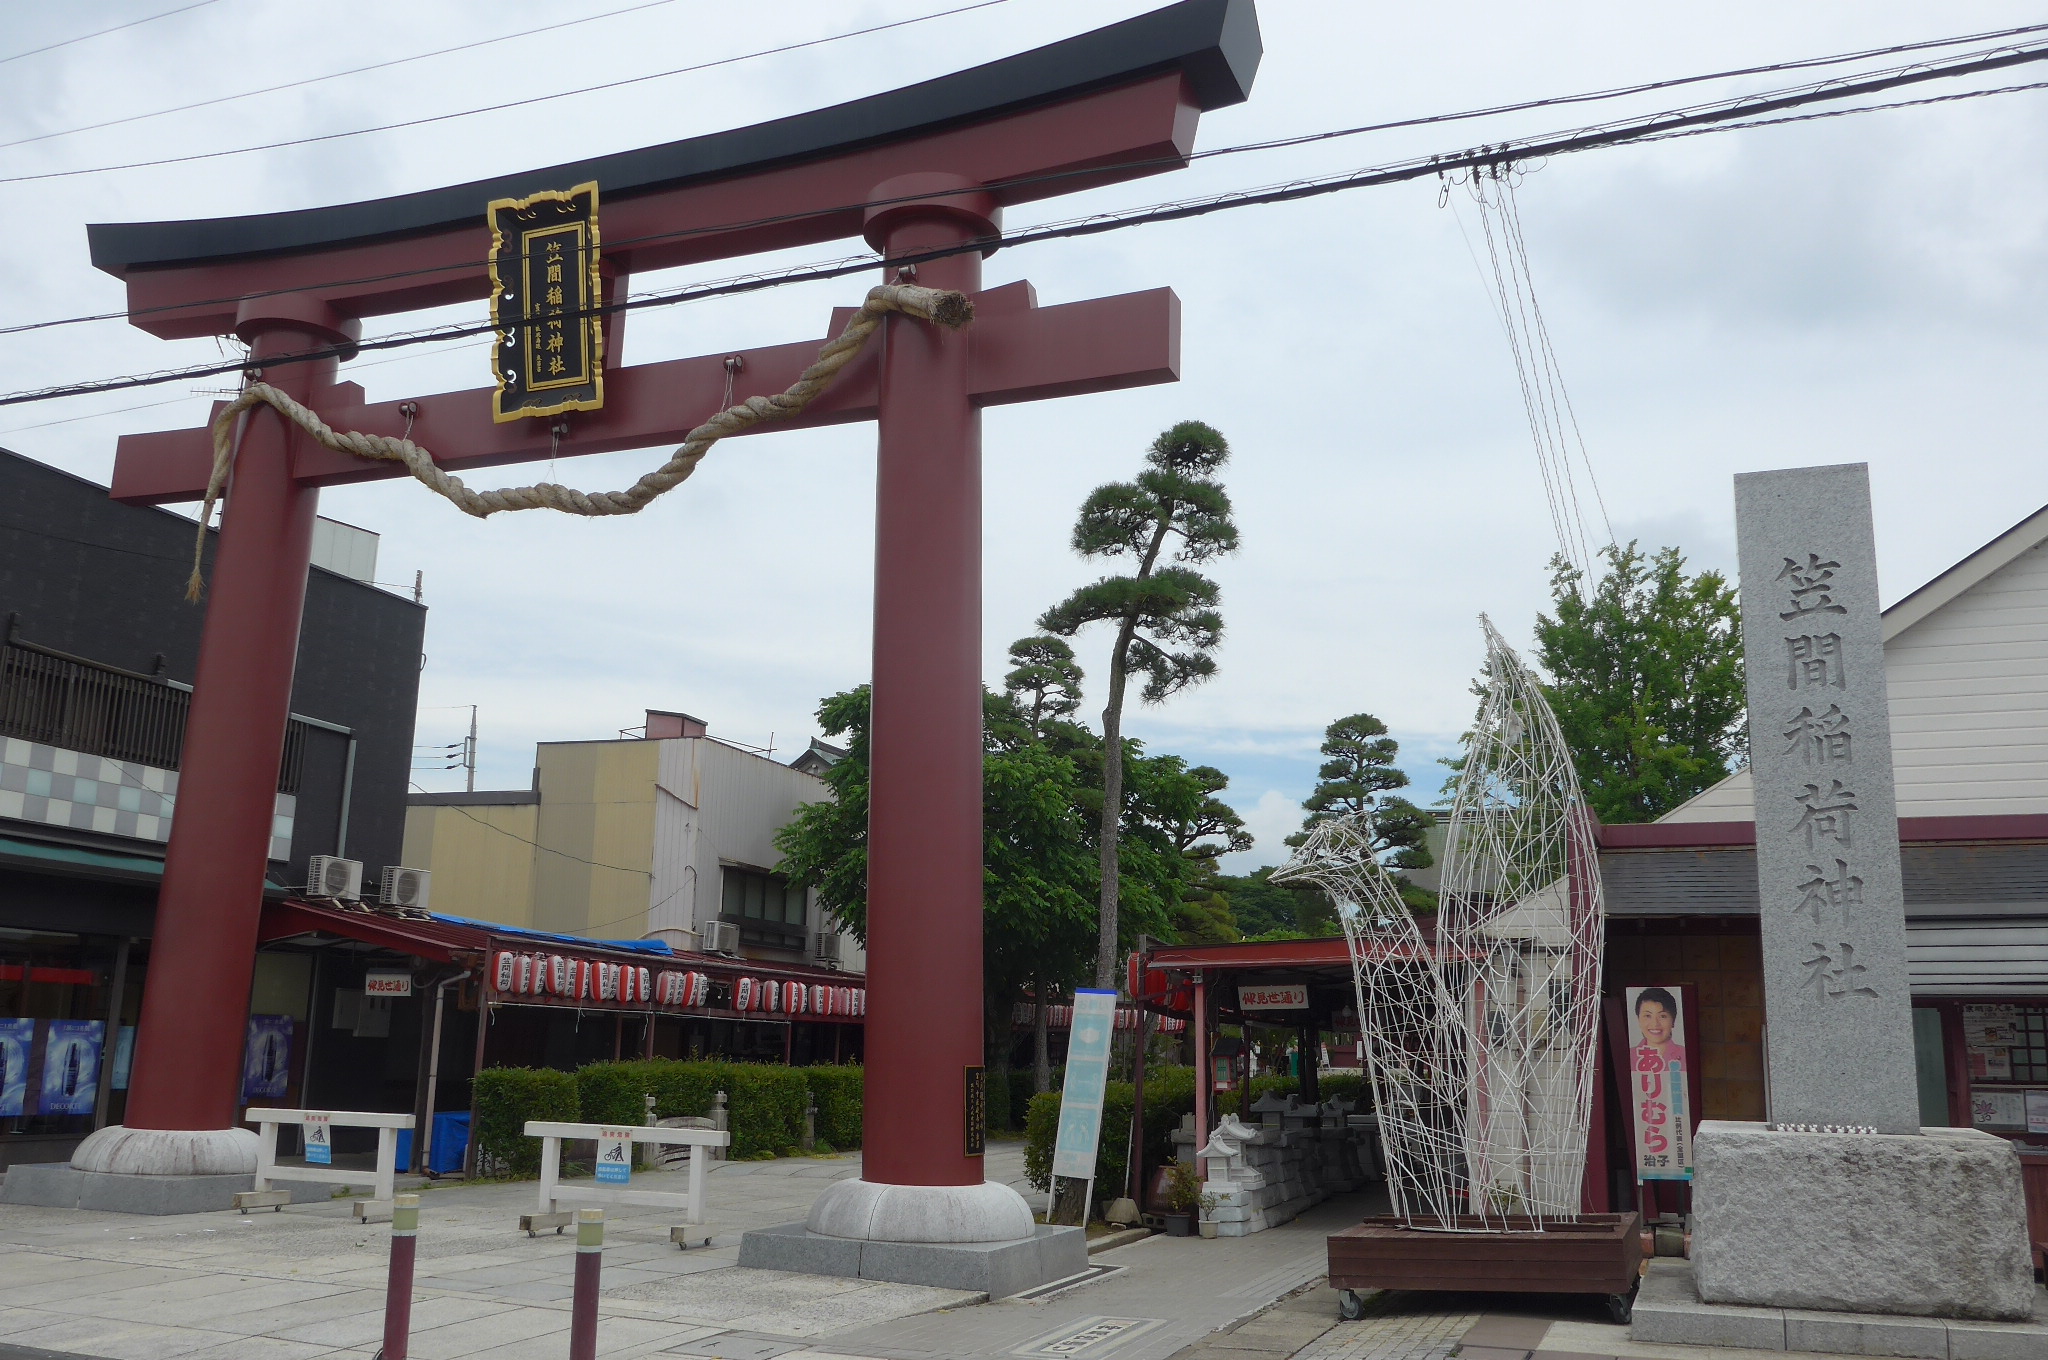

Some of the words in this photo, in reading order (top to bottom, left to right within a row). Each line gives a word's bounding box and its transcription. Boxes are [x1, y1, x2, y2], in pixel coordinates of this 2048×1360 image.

[546, 241, 566, 376] 笠間稲荷神社
[1774, 553, 1880, 1001] 笠間稲荷神社
[500, 957, 511, 986] 笠間稲荷
[739, 982, 749, 1007] 笠間稲荷
[1638, 1047, 1668, 1153] ありむら
[1644, 1155, 1670, 1167] 治子
